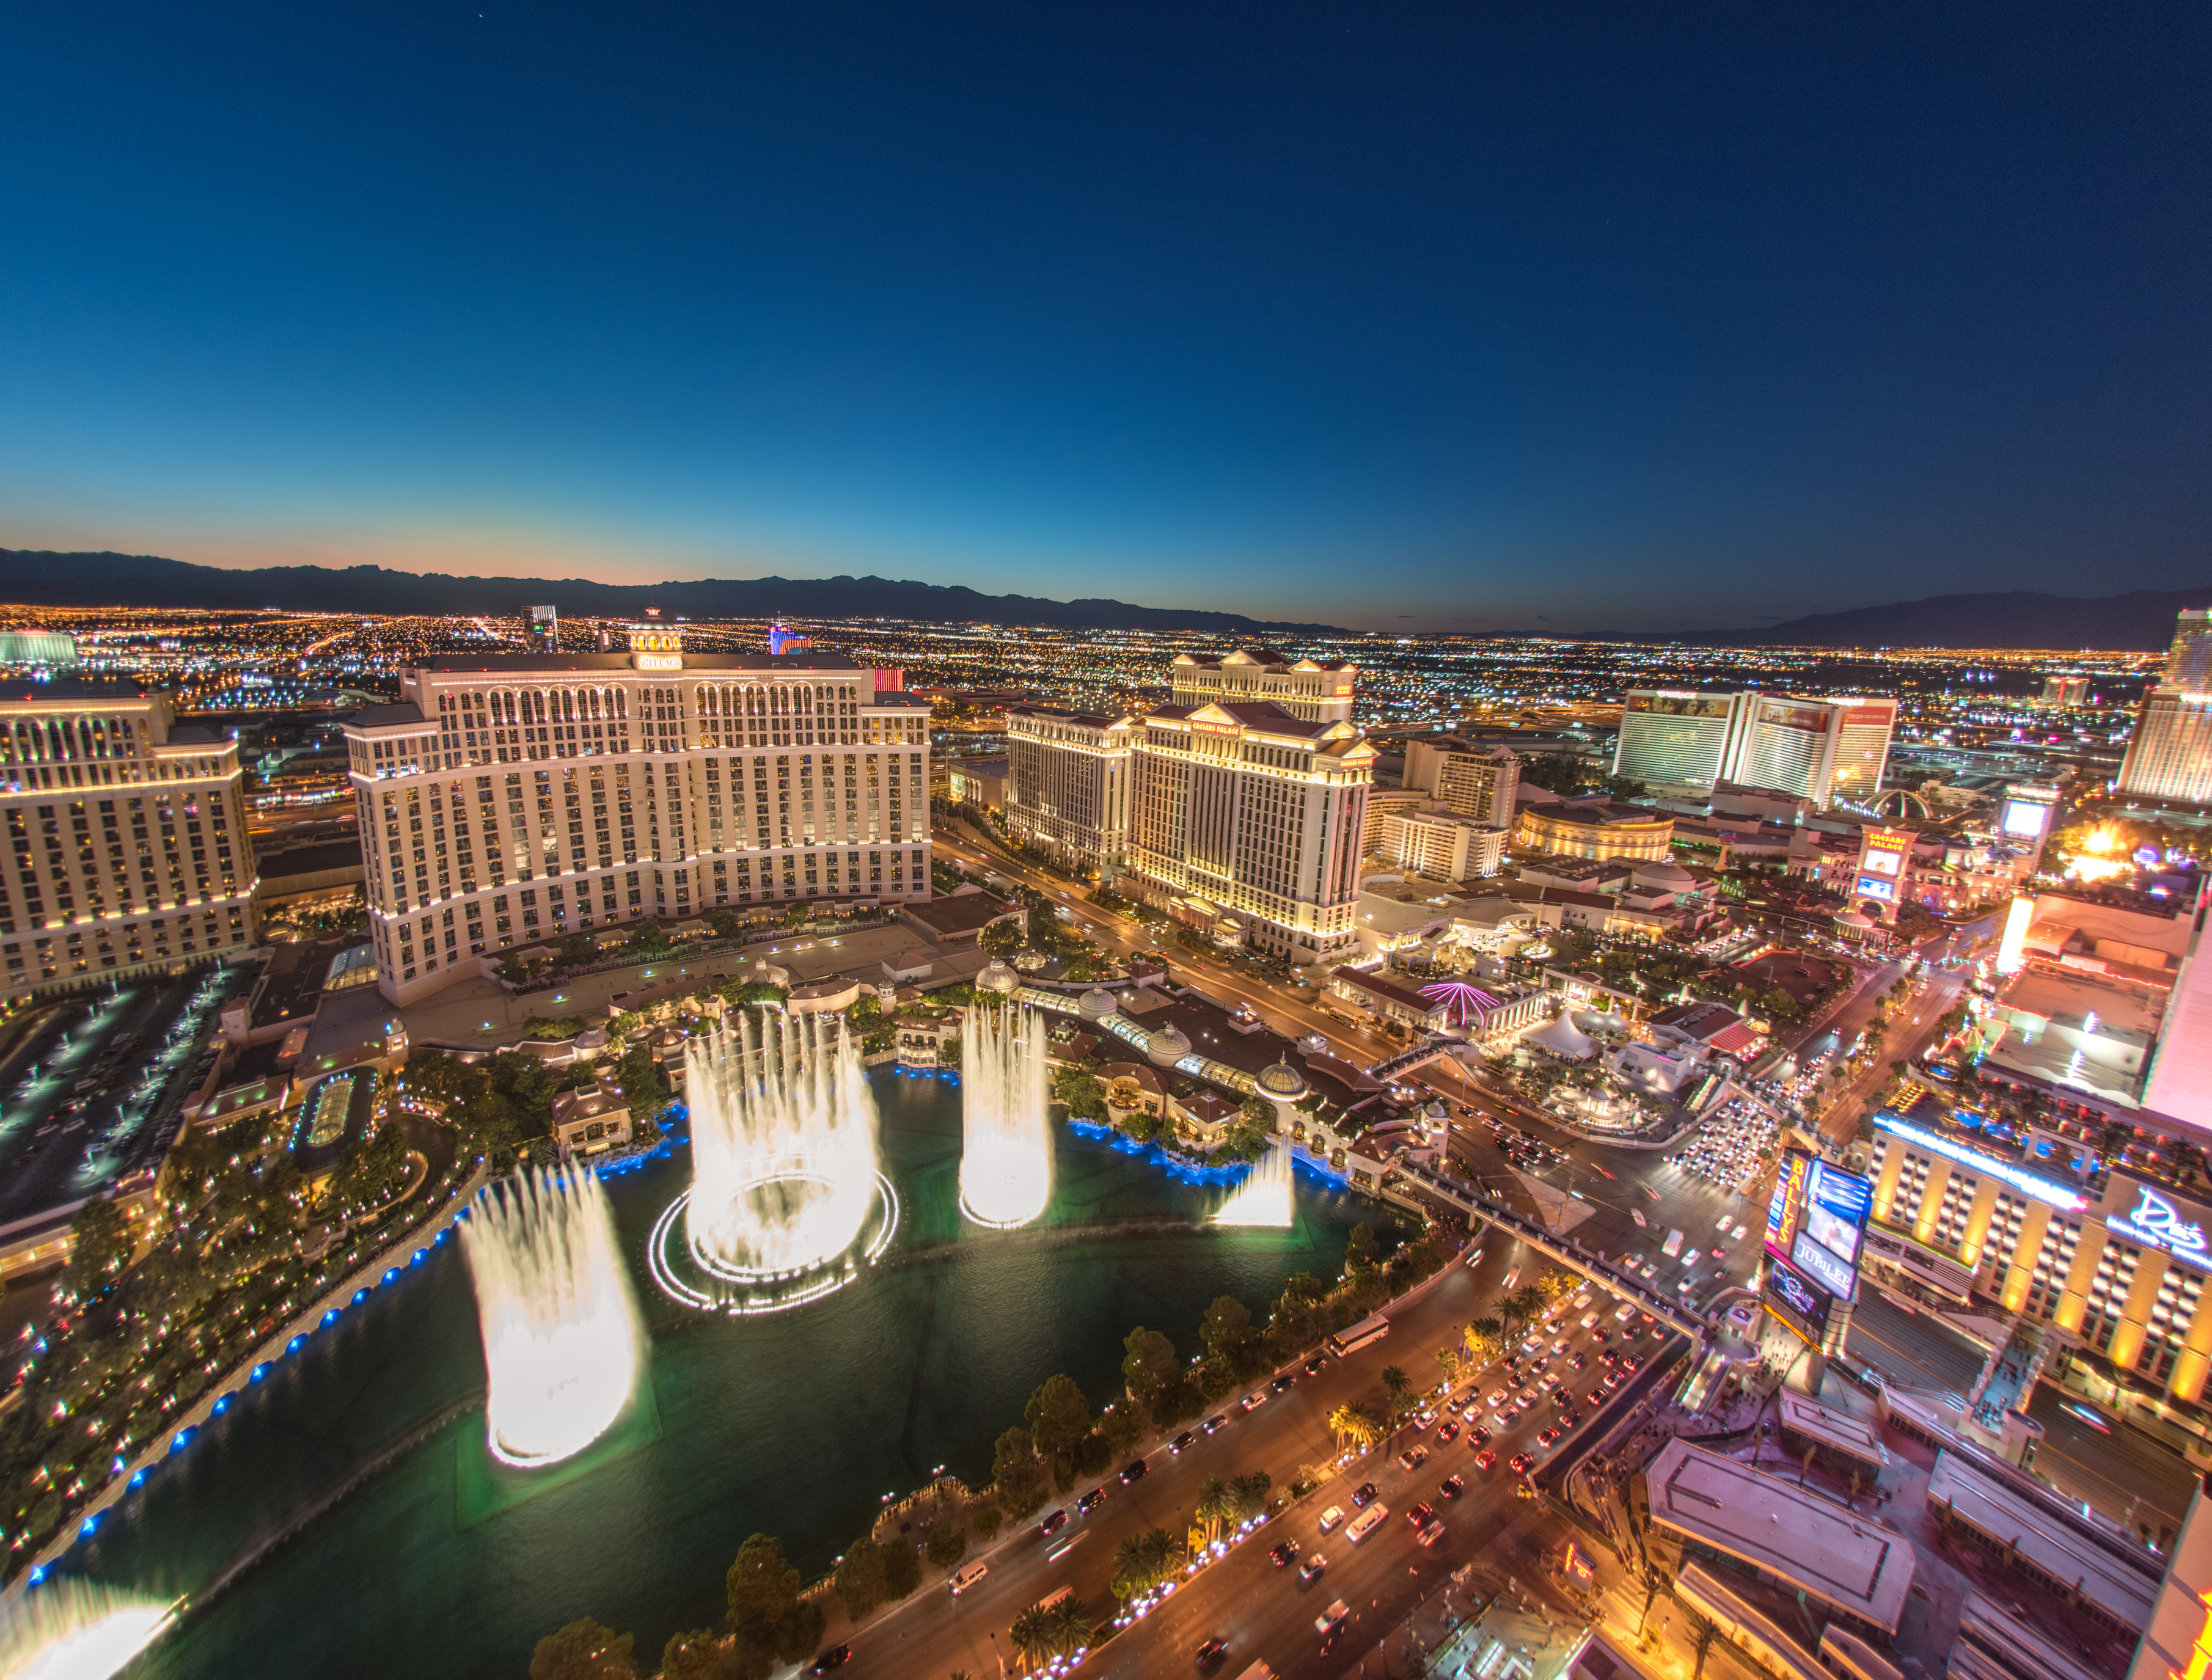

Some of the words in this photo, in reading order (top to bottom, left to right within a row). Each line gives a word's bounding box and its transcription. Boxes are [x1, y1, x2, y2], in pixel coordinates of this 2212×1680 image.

[639, 657, 683, 667] BELLAGIO
[1192, 722, 1216, 732] CAESARS
[1216, 726, 1239, 736] PALACE
[1869, 833, 1906, 845] CAESARS
[1869, 839, 1903, 851] PALACE
[1779, 1158, 1804, 1243] BALLYS
[1794, 1243, 1851, 1289] JUBILEE
